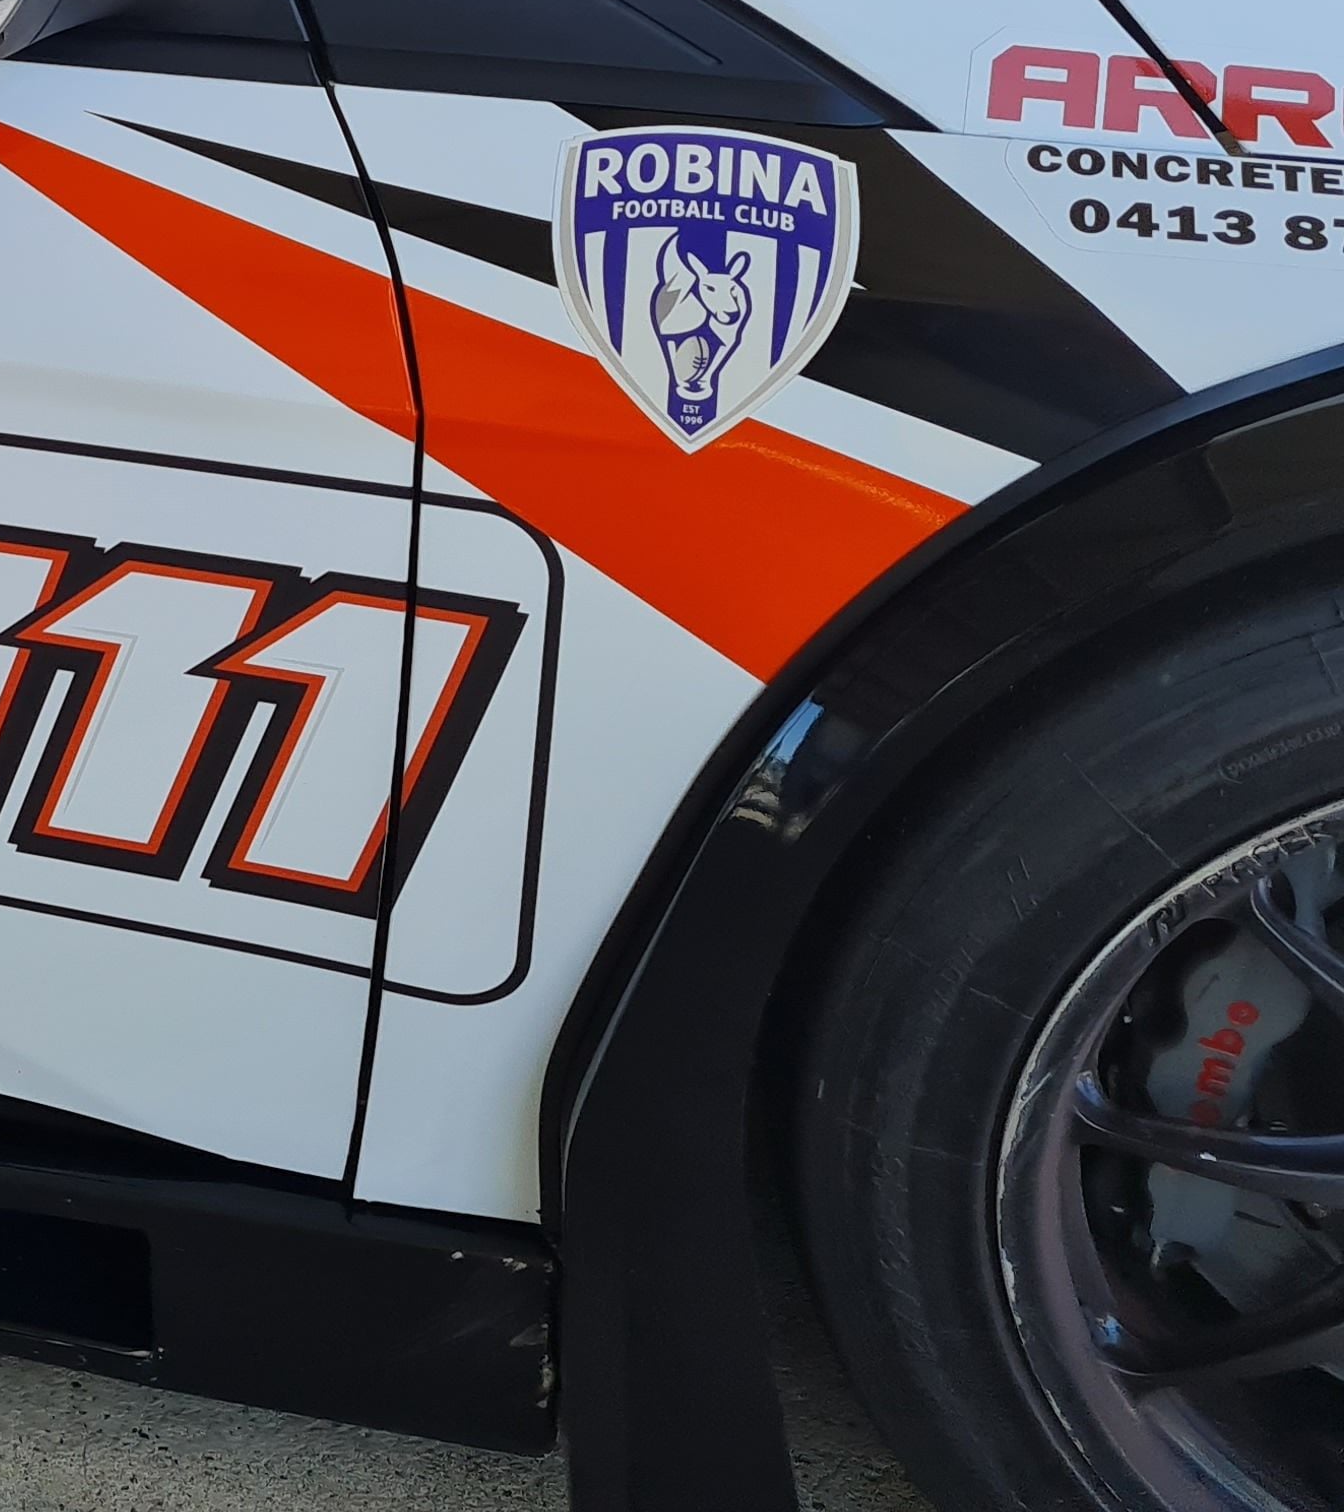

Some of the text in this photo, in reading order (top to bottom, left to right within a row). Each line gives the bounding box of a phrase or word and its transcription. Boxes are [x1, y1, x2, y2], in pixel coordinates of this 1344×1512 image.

[987, 45, 1344, 148] ARR
[584, 143, 827, 216] ROBINA
[1027, 144, 1344, 196] CONCRETE
[612, 199, 795, 232] FOOTBALL CLUB
[1070, 198, 1256, 245] 0413
[679, 414, 703, 425] 1996
[683, 404, 700, 414] EST
